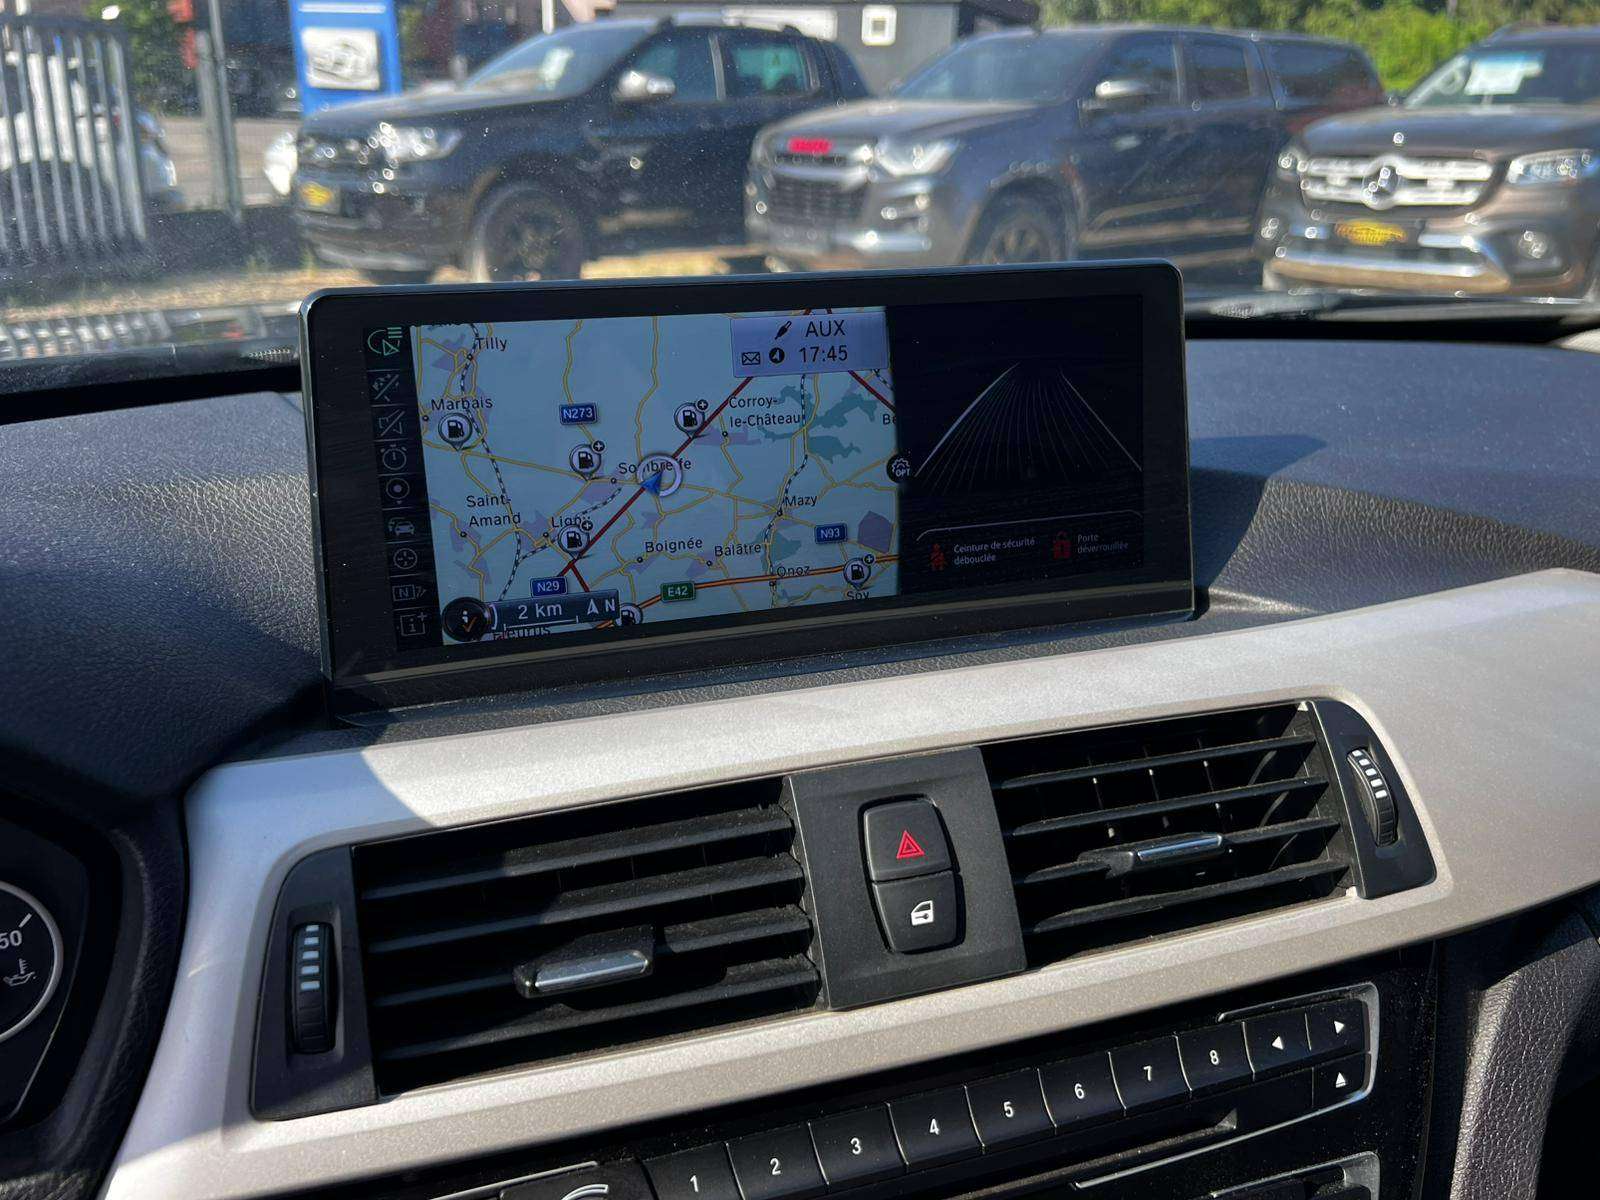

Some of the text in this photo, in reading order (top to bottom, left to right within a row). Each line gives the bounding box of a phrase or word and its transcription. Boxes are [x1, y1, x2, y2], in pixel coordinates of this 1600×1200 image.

[806, 320, 846, 338] AUX
[475, 336, 507, 352] Tilly
[799, 345, 848, 362] 17:45
[431, 396, 493, 411] Marbais
[728, 395, 777, 409] Corroy-
[562, 407, 593, 419] N273
[730, 412, 801, 428] le-Château
[466, 494, 511, 508] Saint-
[785, 494, 818, 508] Mazy
[469, 511, 521, 528] Amand
[820, 527, 841, 539] N93
[1077, 532, 1099, 544] Porte
[645, 536, 703, 553] Boignée
[714, 542, 761, 557] Balâtre
[953, 537, 1035, 554] Ceinture de sécurité
[953, 553, 996, 566] débouclée
[776, 565, 810, 577] Onoz
[537, 580, 560, 592] N29
[667, 585, 689, 598] E42
[517, 603, 562, 619] 2 km
[1209, 1049, 1219, 1065] 8
[1143, 1065, 1153, 1081] 7
[1074, 1082, 1085, 1099] 6
[1003, 1101, 1015, 1118] 5
[929, 1118, 939, 1135] 4
[850, 1137, 862, 1155] 3
[769, 1157, 781, 1176] 2
[689, 1174, 699, 1192] 1
